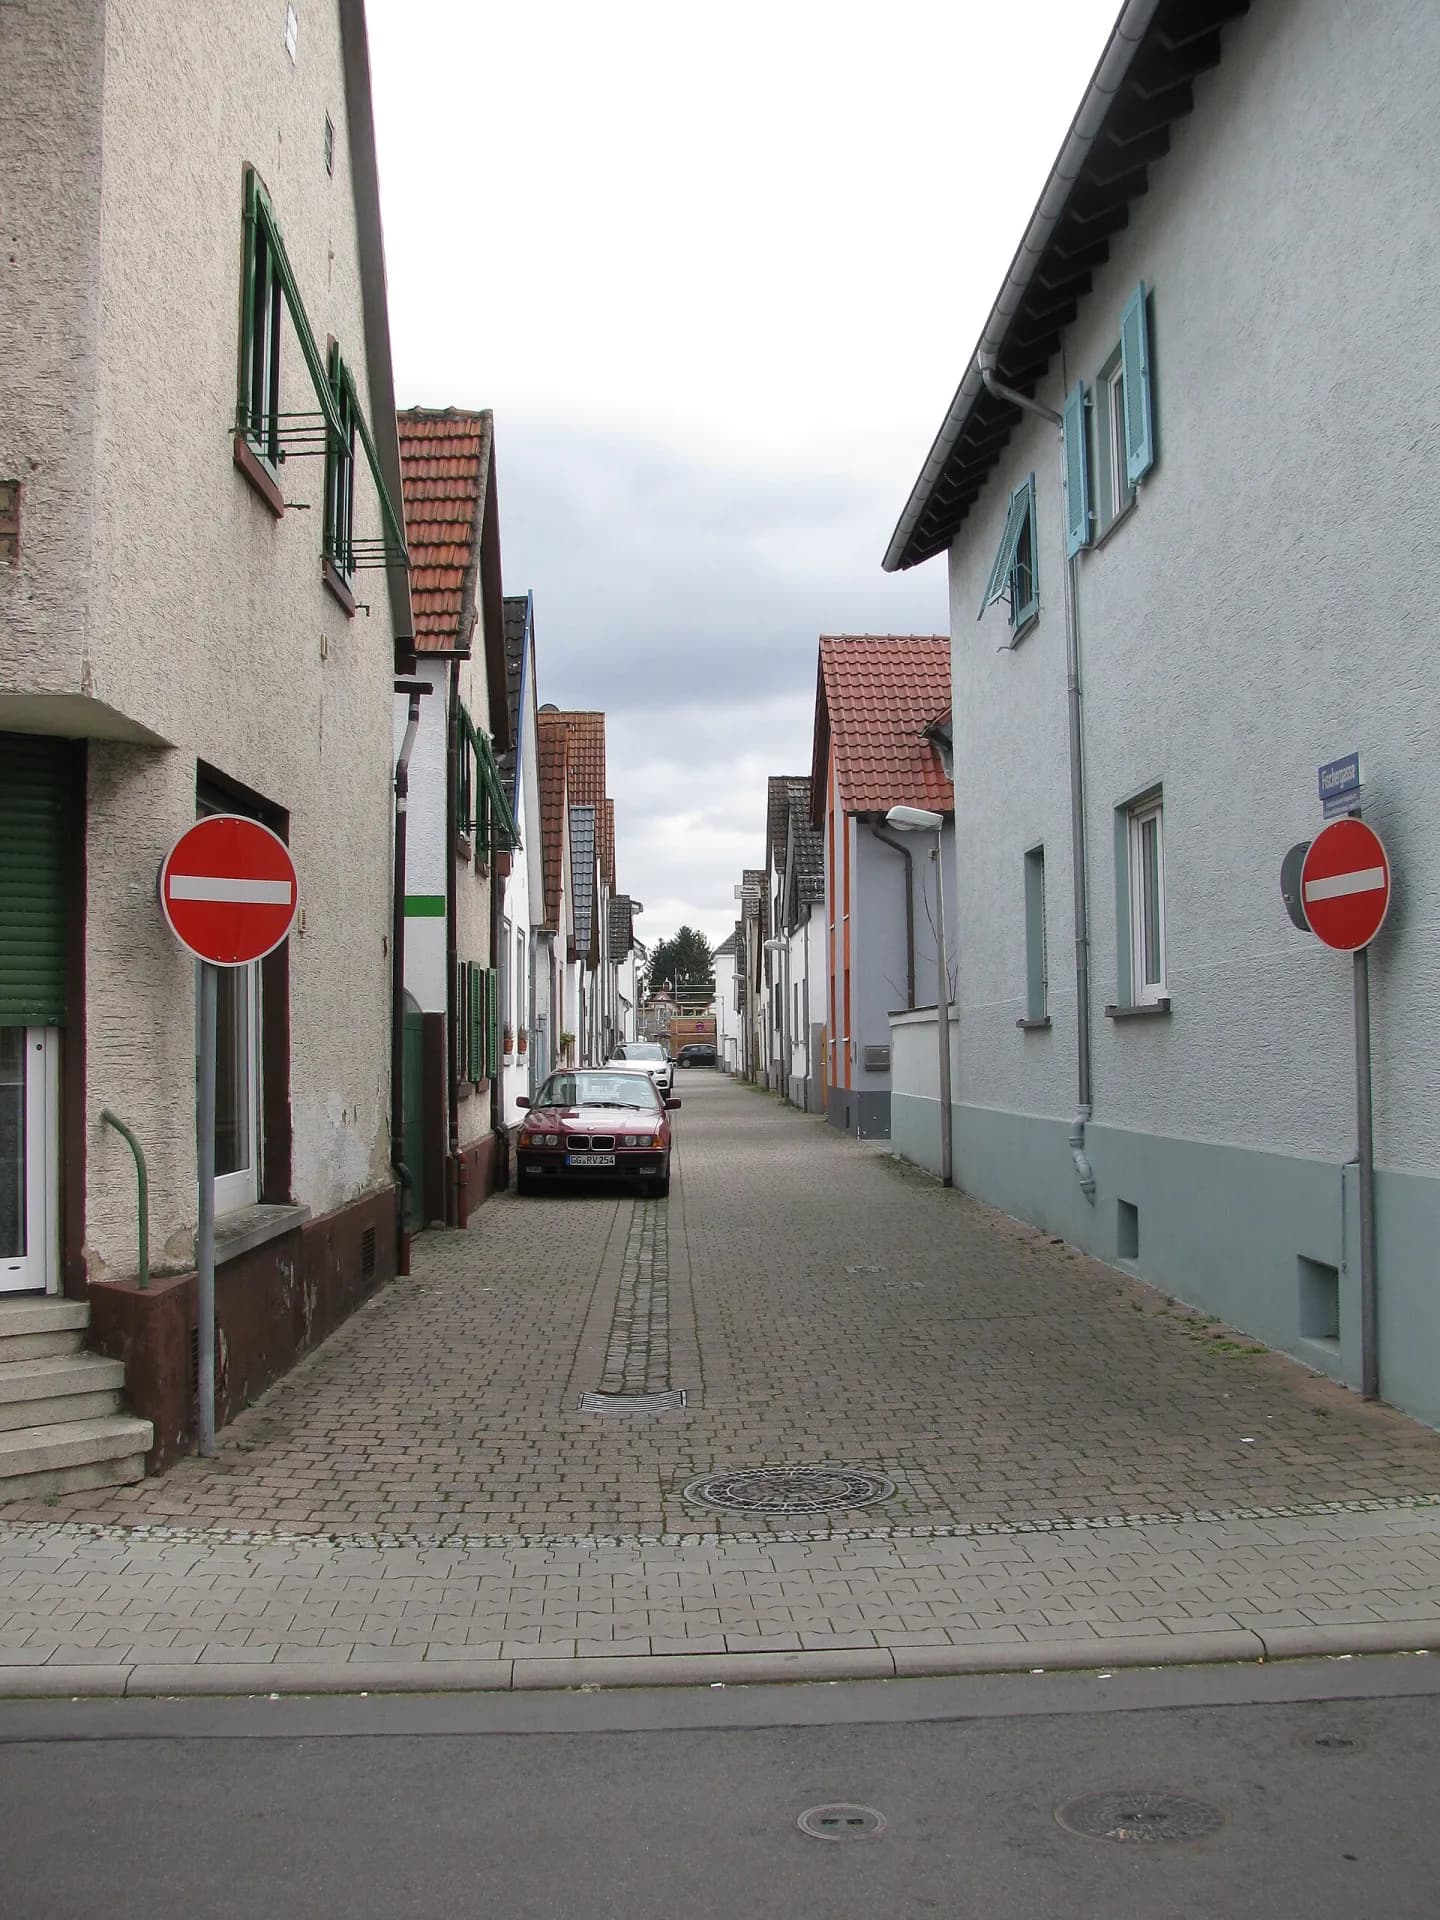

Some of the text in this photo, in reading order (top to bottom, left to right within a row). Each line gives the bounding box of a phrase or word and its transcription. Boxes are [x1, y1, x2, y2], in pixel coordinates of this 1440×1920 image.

[1321, 764, 1355, 790] Fischergasse
[571, 1155, 614, 1165] GG RV 254
